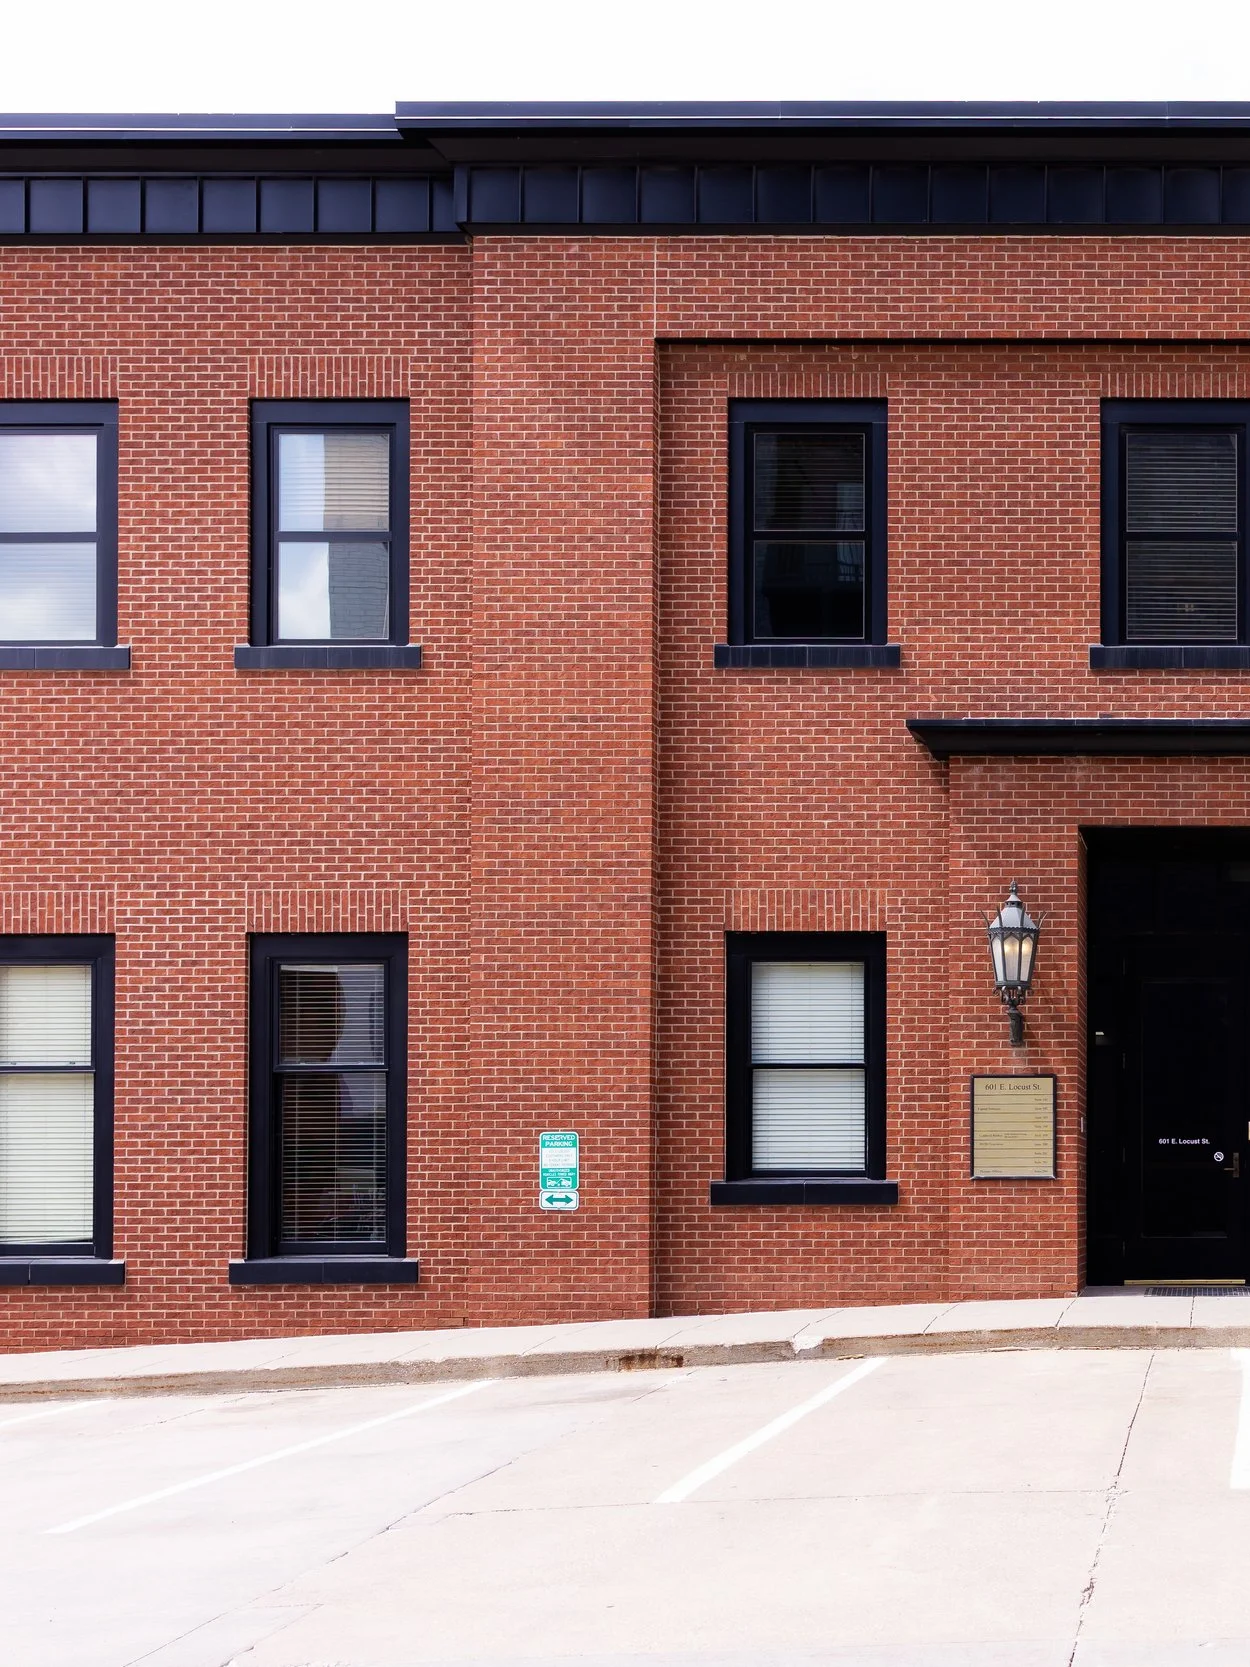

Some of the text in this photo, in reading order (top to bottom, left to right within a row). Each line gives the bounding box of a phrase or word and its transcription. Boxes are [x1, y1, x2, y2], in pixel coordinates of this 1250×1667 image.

[985, 1083, 997, 1091] 601
[1000, 1083, 1007, 1091] E.
[1009, 1083, 1031, 1091] Locust
